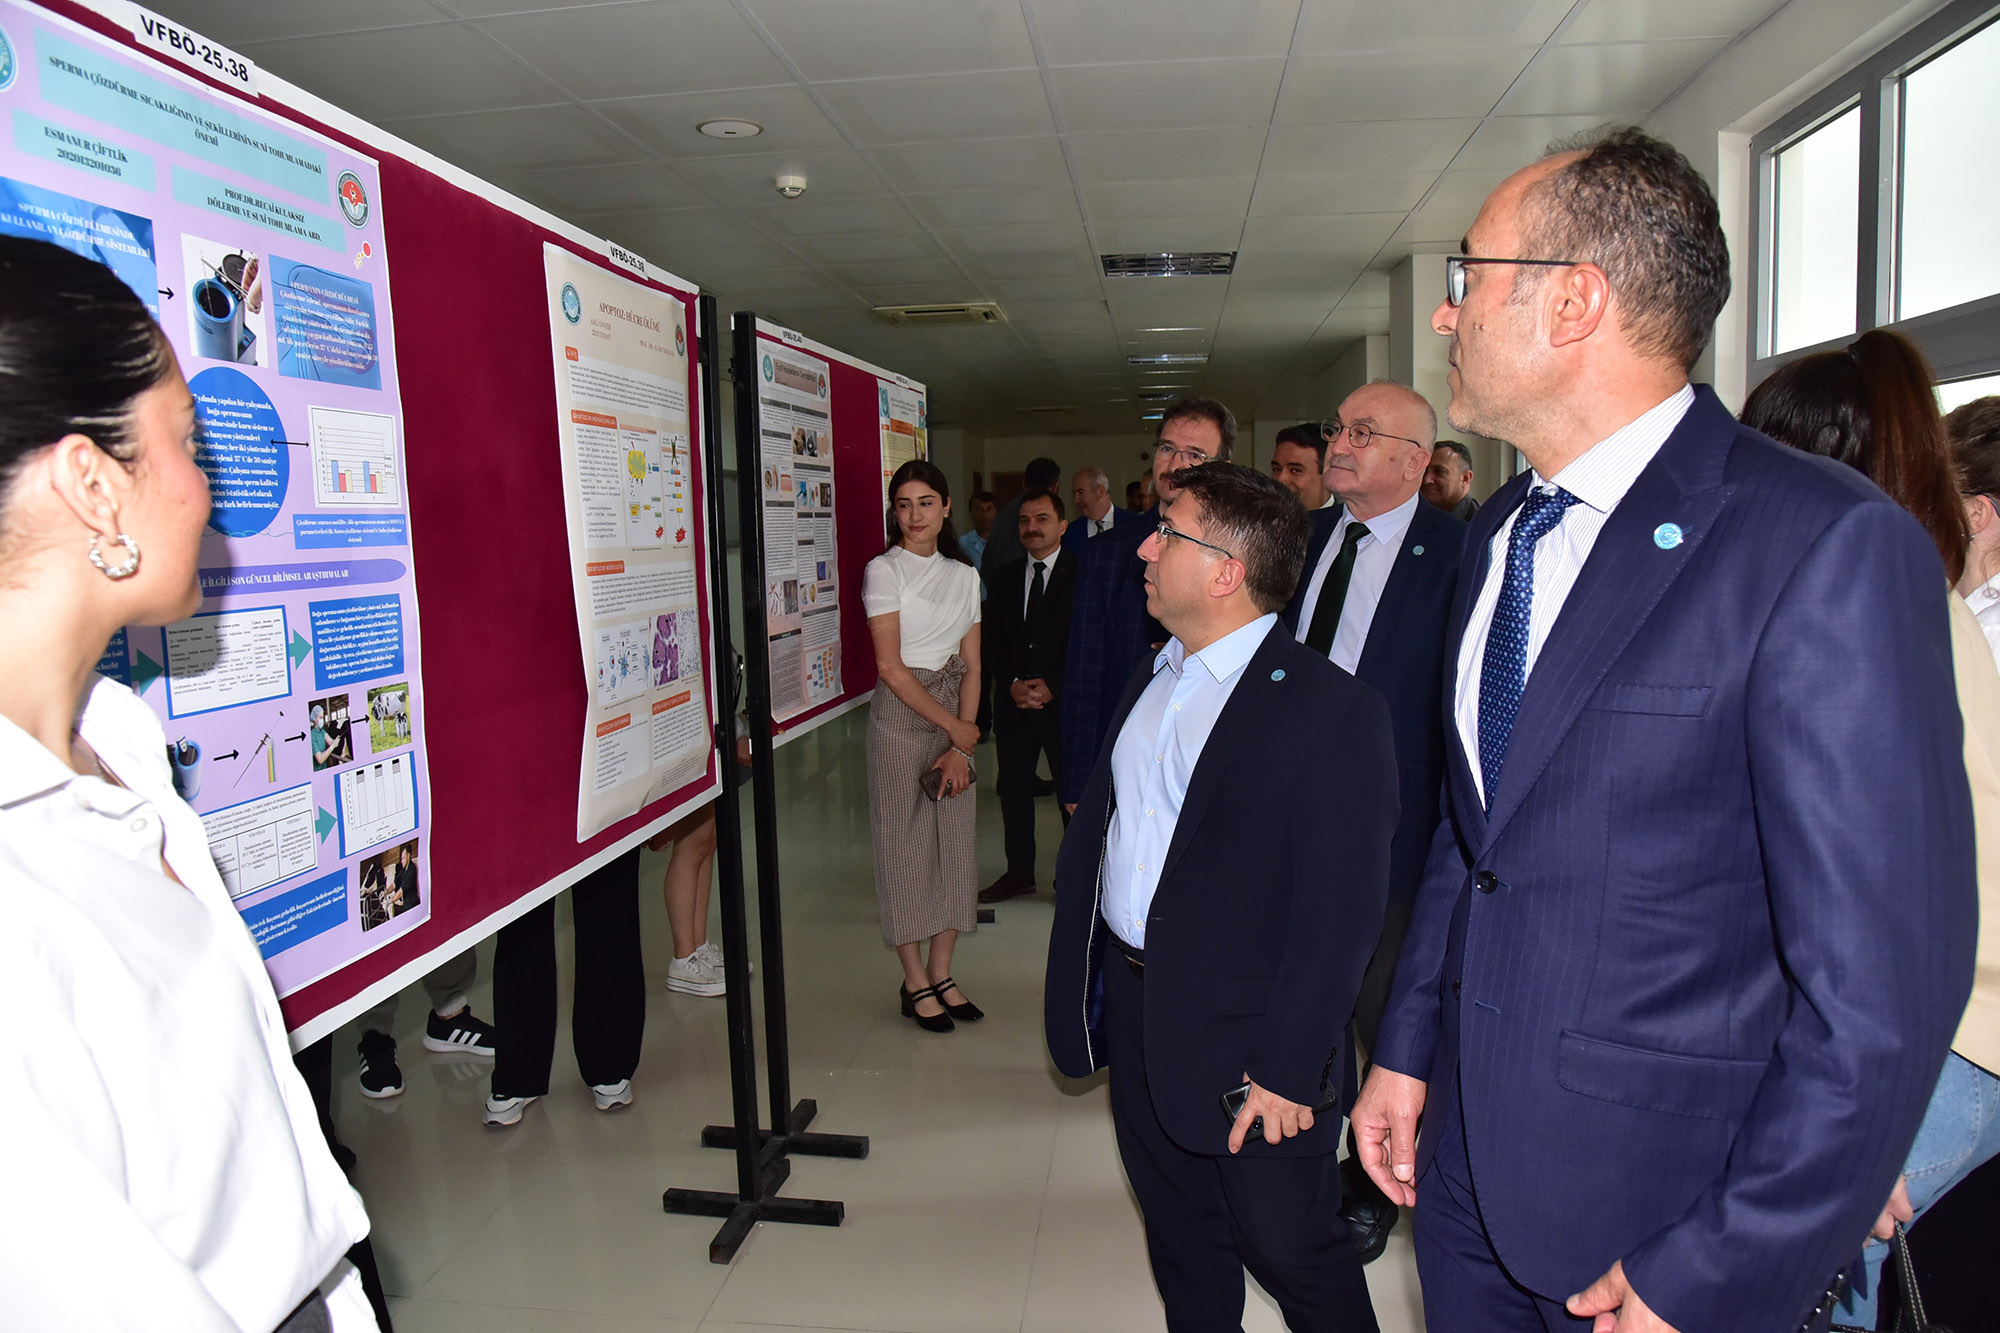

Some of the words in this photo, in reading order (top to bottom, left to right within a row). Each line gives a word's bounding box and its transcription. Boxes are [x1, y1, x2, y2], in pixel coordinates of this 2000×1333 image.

[140, 14, 249, 82] VFBÖ-25.38
[49, 56, 89, 80] SPERMA
[90, 73, 139, 100] ÇÖZDÜRME
[193, 115, 204, 126] VE
[44, 126, 91, 151] ESMANUR
[92, 142, 128, 163] ÇİFTLİK
[194, 129, 219, 147] ÖNEMİ
[207, 196, 242, 215] DÖLERME
[231, 576, 246, 586] SON
[246, 573, 272, 585] GÜNCEL
